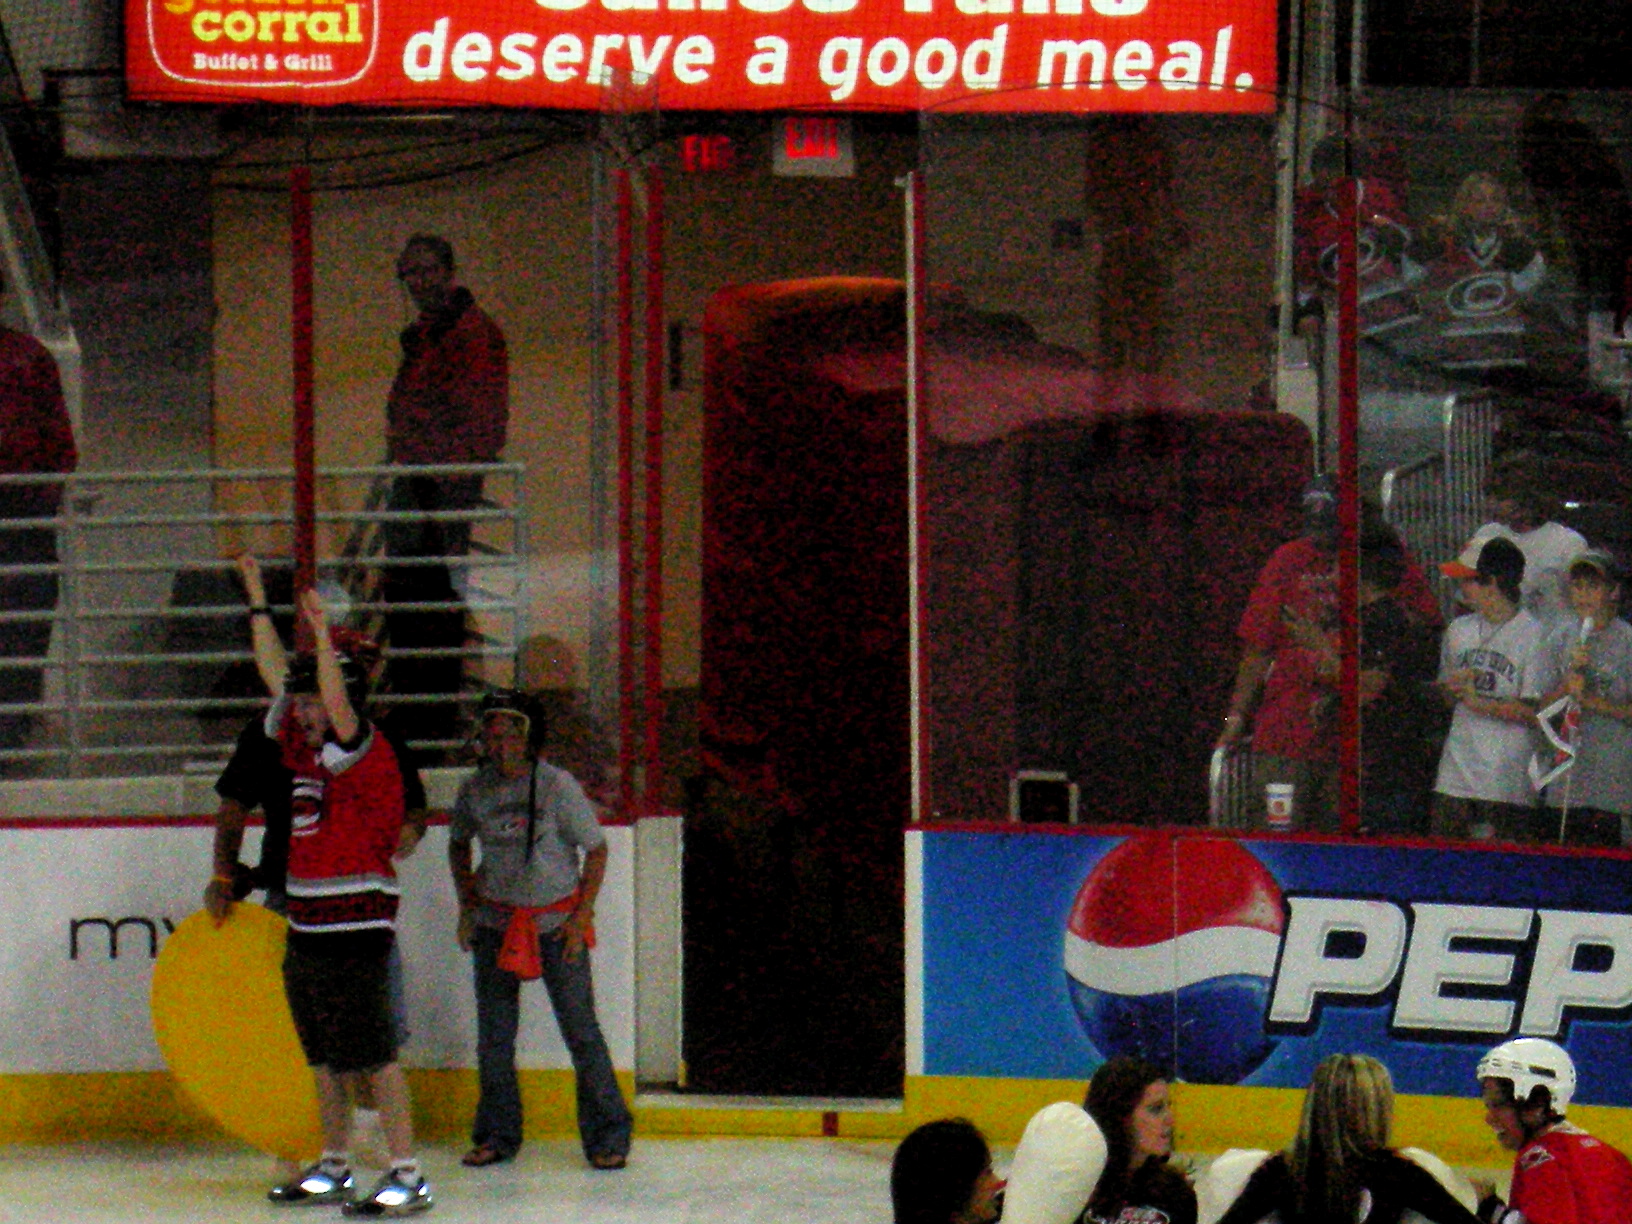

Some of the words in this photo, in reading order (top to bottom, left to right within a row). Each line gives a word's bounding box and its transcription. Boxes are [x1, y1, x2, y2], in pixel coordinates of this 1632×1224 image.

[190, 3, 364, 43] corral
[193, 52, 258, 71] Buffet
[263, 53, 279, 71] &
[284, 54, 333, 72] Grill
[402, 16, 716, 86] deserve
[744, 35, 790, 86] a
[818, 23, 1009, 101] good
[1036, 25, 1255, 92] meal.
